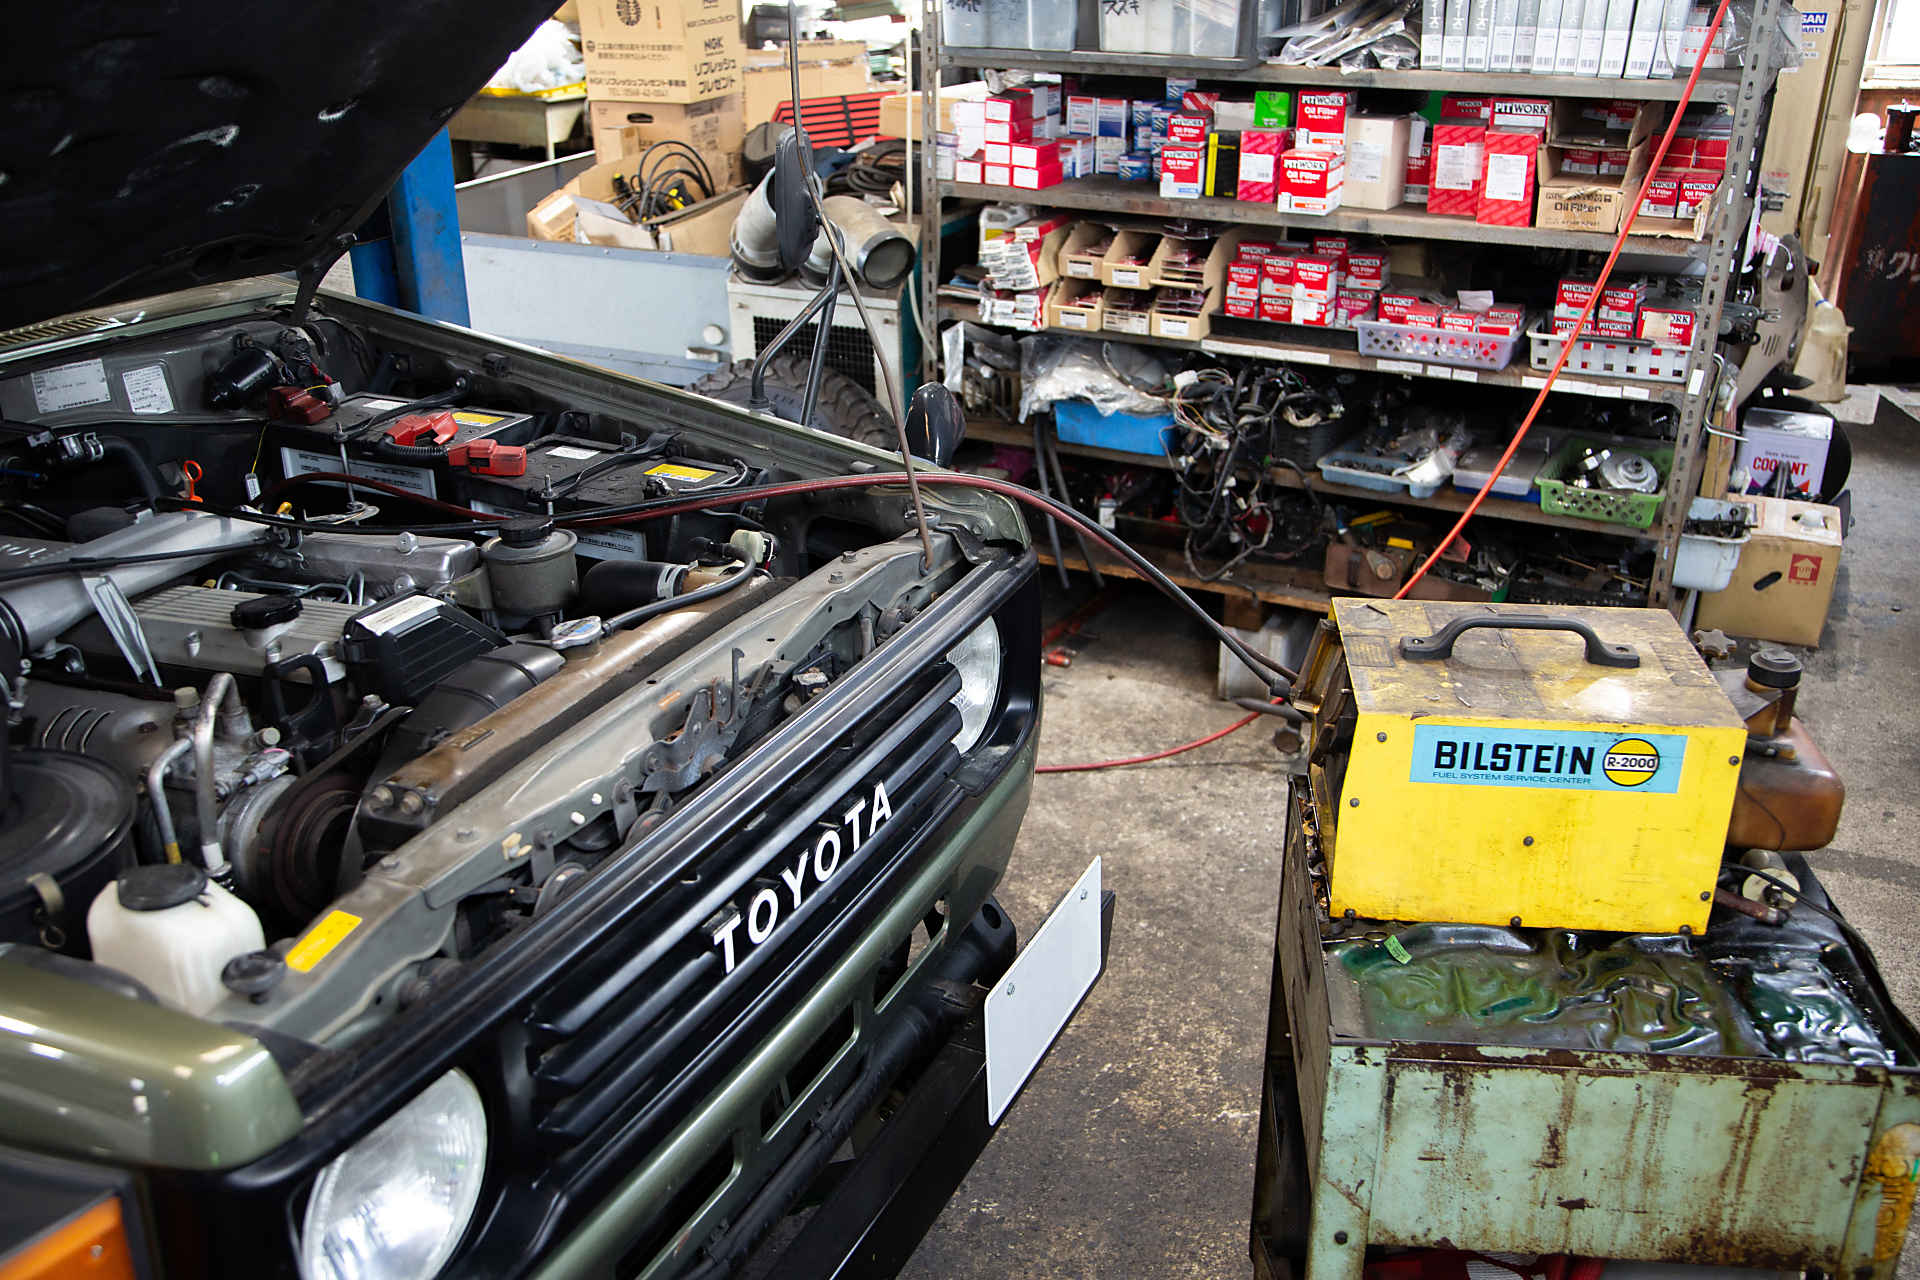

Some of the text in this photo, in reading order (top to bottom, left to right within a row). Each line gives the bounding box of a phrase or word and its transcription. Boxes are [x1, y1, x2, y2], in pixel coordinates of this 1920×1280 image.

[704, 37, 724, 51] NGK
[694, 58, 737, 77] リフレッシュ
[698, 75, 736, 95] プレゼント
[1301, 95, 1344, 106] PITWORK
[1304, 106, 1339, 116] Oil Filter
[1494, 102, 1549, 115] PITWORK
[1170, 118, 1204, 127] PITWORK
[1164, 150, 1198, 159] PITWORK
[1284, 159, 1326, 171] PITWORK
[1286, 171, 1321, 180] Oil Filter
[1554, 202, 1602, 213] Oil Filter
[1752, 456, 1809, 476] COONT
[1434, 740, 1656, 775] BILSTEIN R-2000
[1432, 771, 1591, 785] FUEL SYSTEM SERVICE CENTER
[712, 780, 893, 974] TOYOTA
